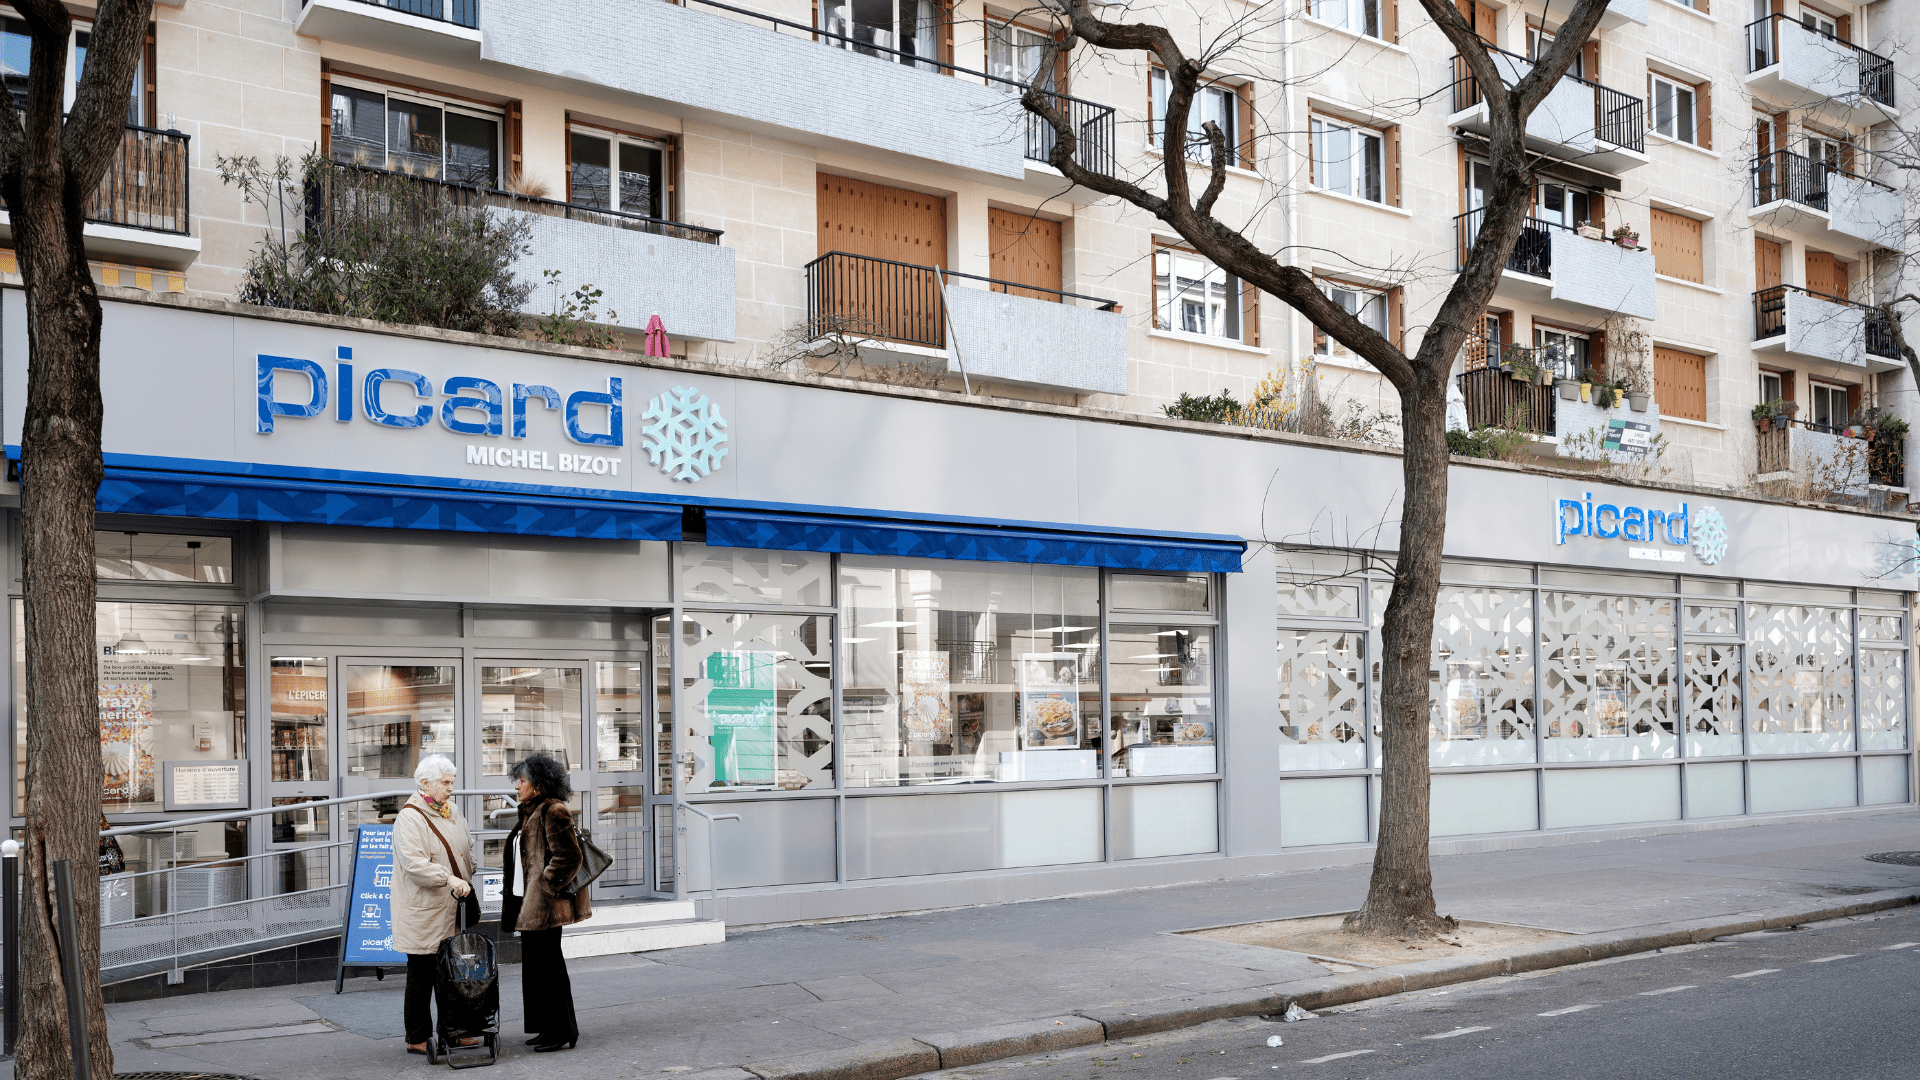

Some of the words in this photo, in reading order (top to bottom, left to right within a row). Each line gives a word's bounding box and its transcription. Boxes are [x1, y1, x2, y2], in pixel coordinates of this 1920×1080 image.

[256, 345, 623, 447] picard
[466, 445, 553, 471] MICHEL
[559, 453, 621, 476] BIZOT
[1556, 492, 1688, 545] picard
[656, 644, 669, 657] CK
[908, 670, 944, 679] America
[98, 696, 143, 711] razy
[720, 713, 754, 725] picard
[103, 786, 129, 795] card
[360, 892, 377, 900] Click
[362, 938, 391, 947] picard
